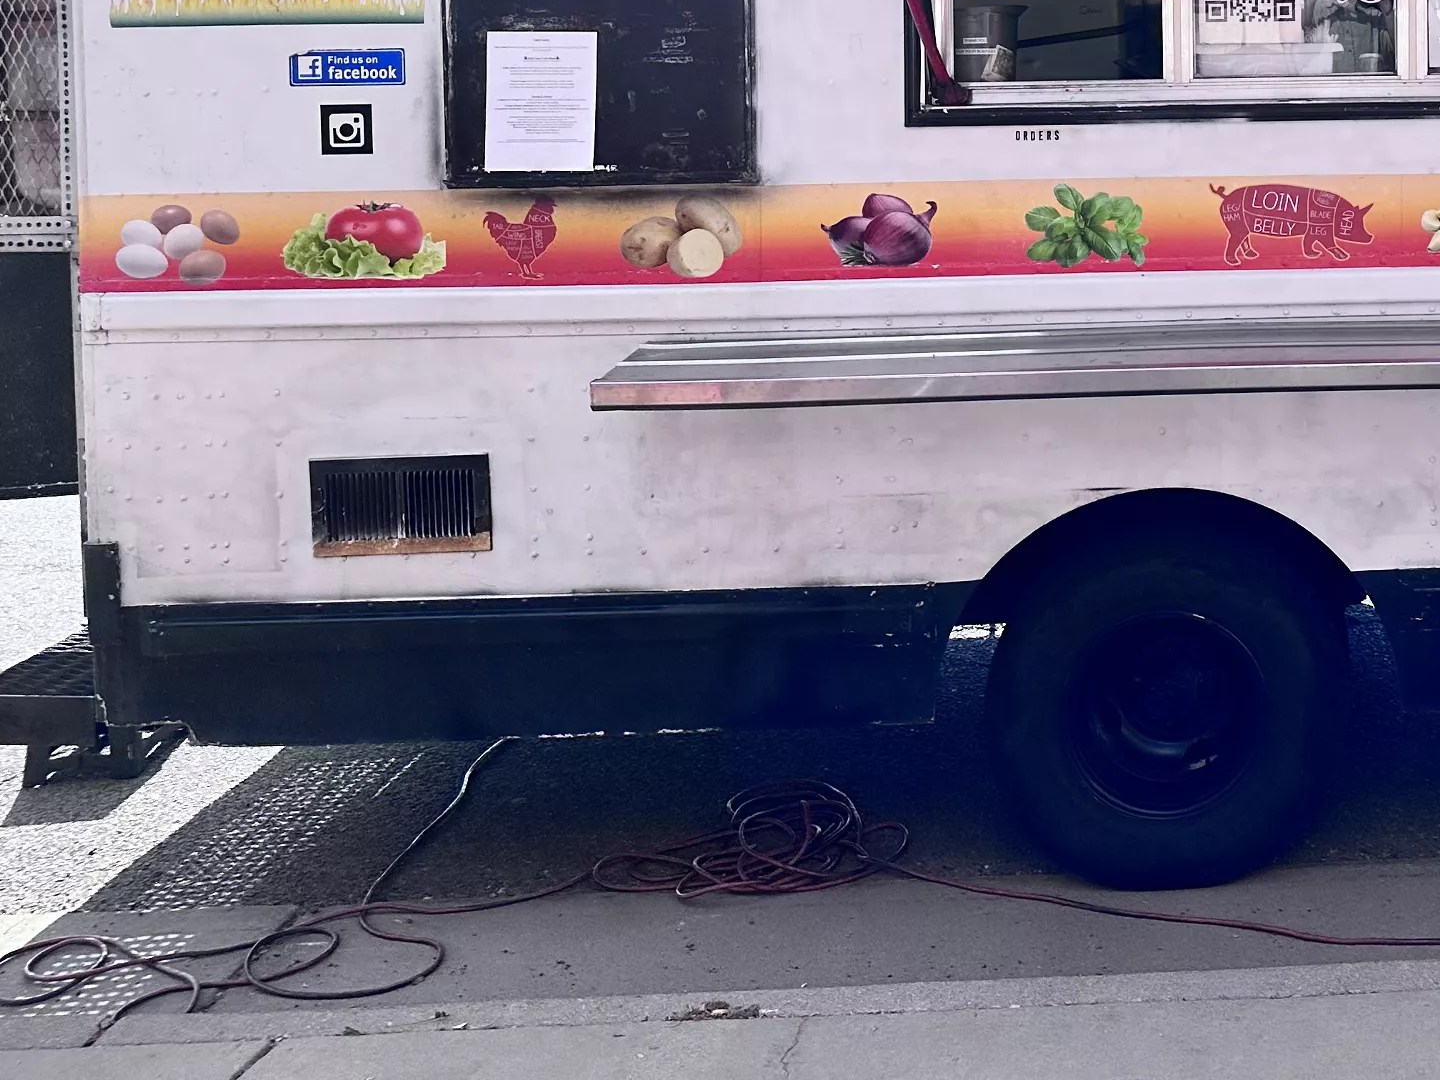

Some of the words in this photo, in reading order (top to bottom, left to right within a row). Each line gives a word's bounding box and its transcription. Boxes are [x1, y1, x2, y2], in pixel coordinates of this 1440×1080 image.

[327, 55, 350, 64] Find
[365, 56, 379, 64] on
[327, 65, 397, 80] facebook
[1015, 130, 1060, 141] ORDERS
[1252, 189, 1300, 213] LOIN
[528, 214, 551, 223] NECK
[1223, 213, 1242, 222] HAM
[1310, 210, 1332, 219] BLADE
[1253, 219, 1296, 236] BELLY
[1339, 210, 1355, 236] HEAD
[1310, 226, 1327, 236] LEG
